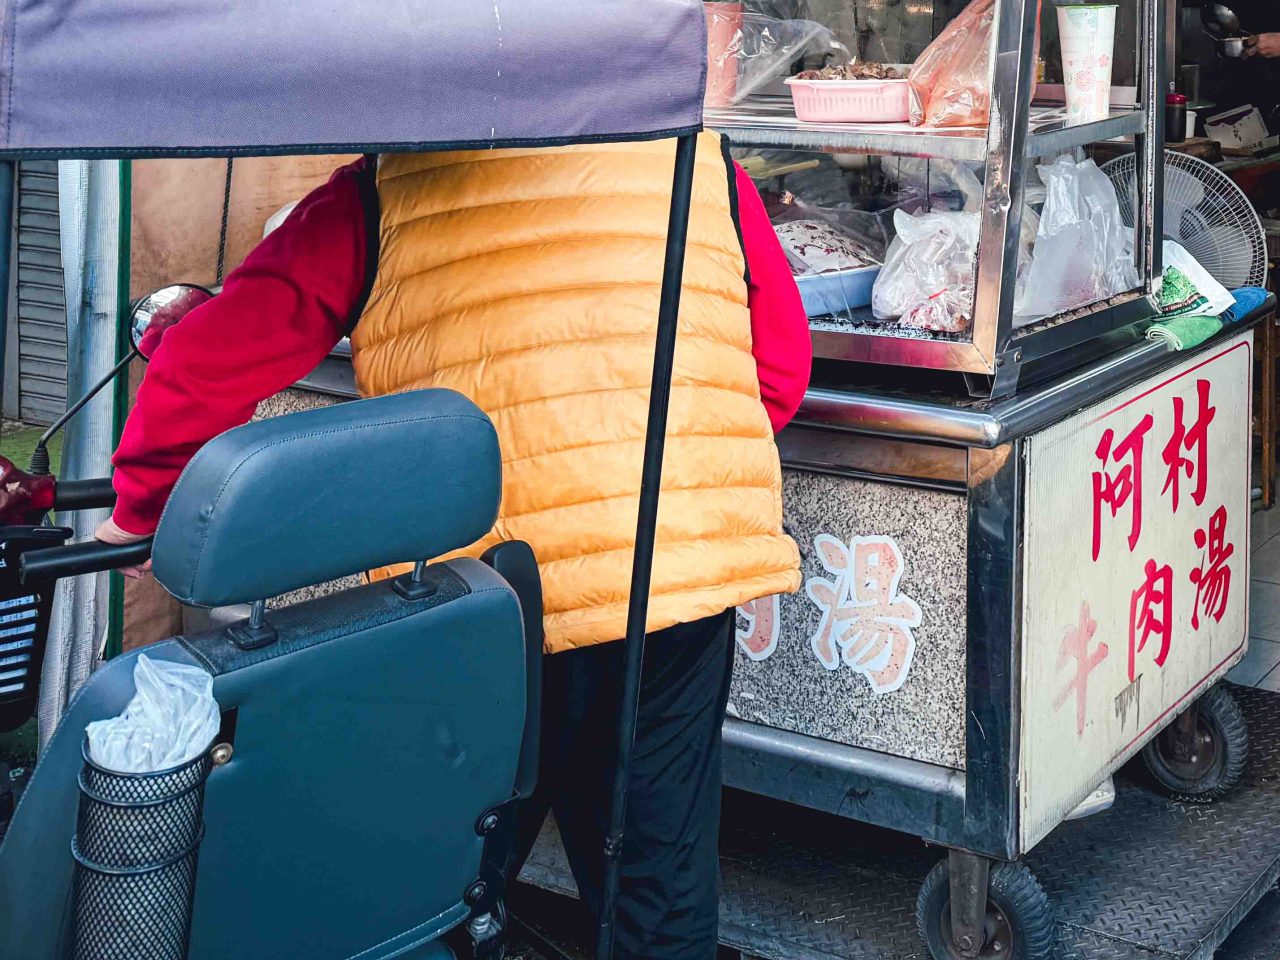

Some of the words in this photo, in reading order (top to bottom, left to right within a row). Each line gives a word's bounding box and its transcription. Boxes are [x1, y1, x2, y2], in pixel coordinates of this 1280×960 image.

[1092, 378, 1216, 562] 阿村
[735, 534, 924, 695] 湯
[1053, 504, 1235, 738] 牛肉湯
